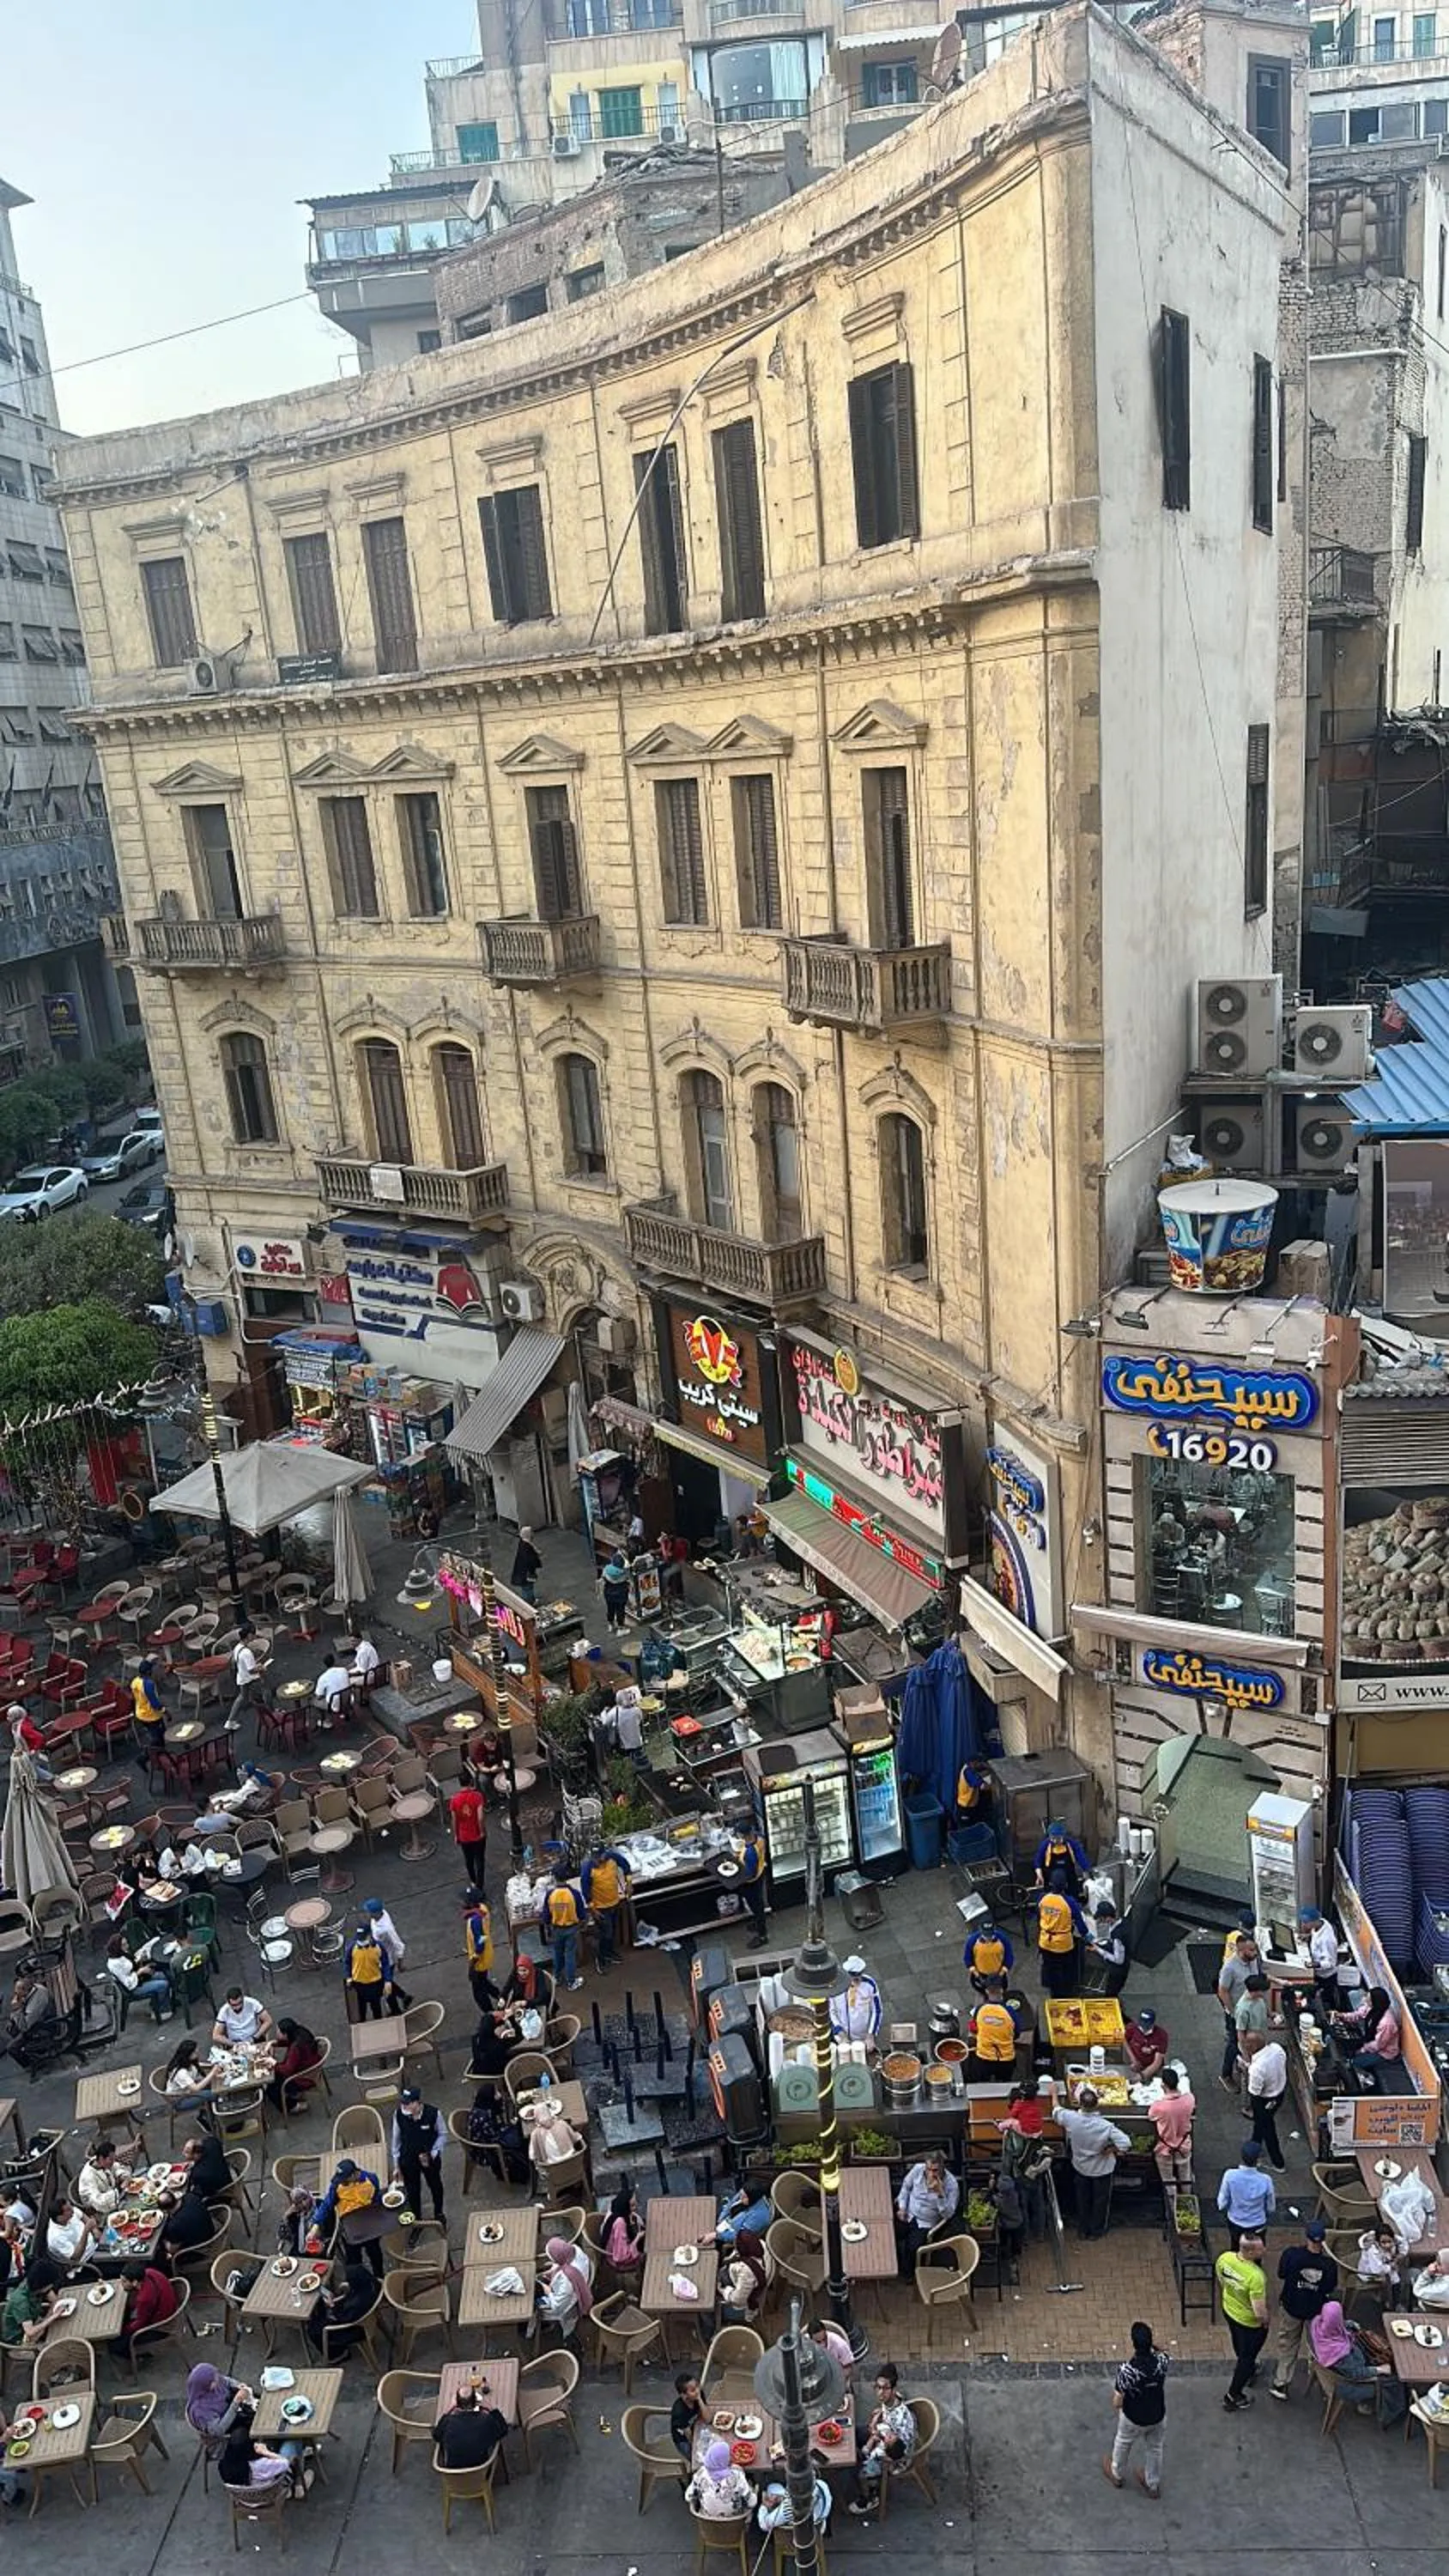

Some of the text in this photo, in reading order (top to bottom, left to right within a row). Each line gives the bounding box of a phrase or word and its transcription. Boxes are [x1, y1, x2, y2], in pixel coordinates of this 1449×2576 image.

[1117, 1356, 1301, 1431] سيد حنفى
[1166, 1430, 1274, 1473] 16920
[1149, 1654, 1274, 1709] سيد حنفى
